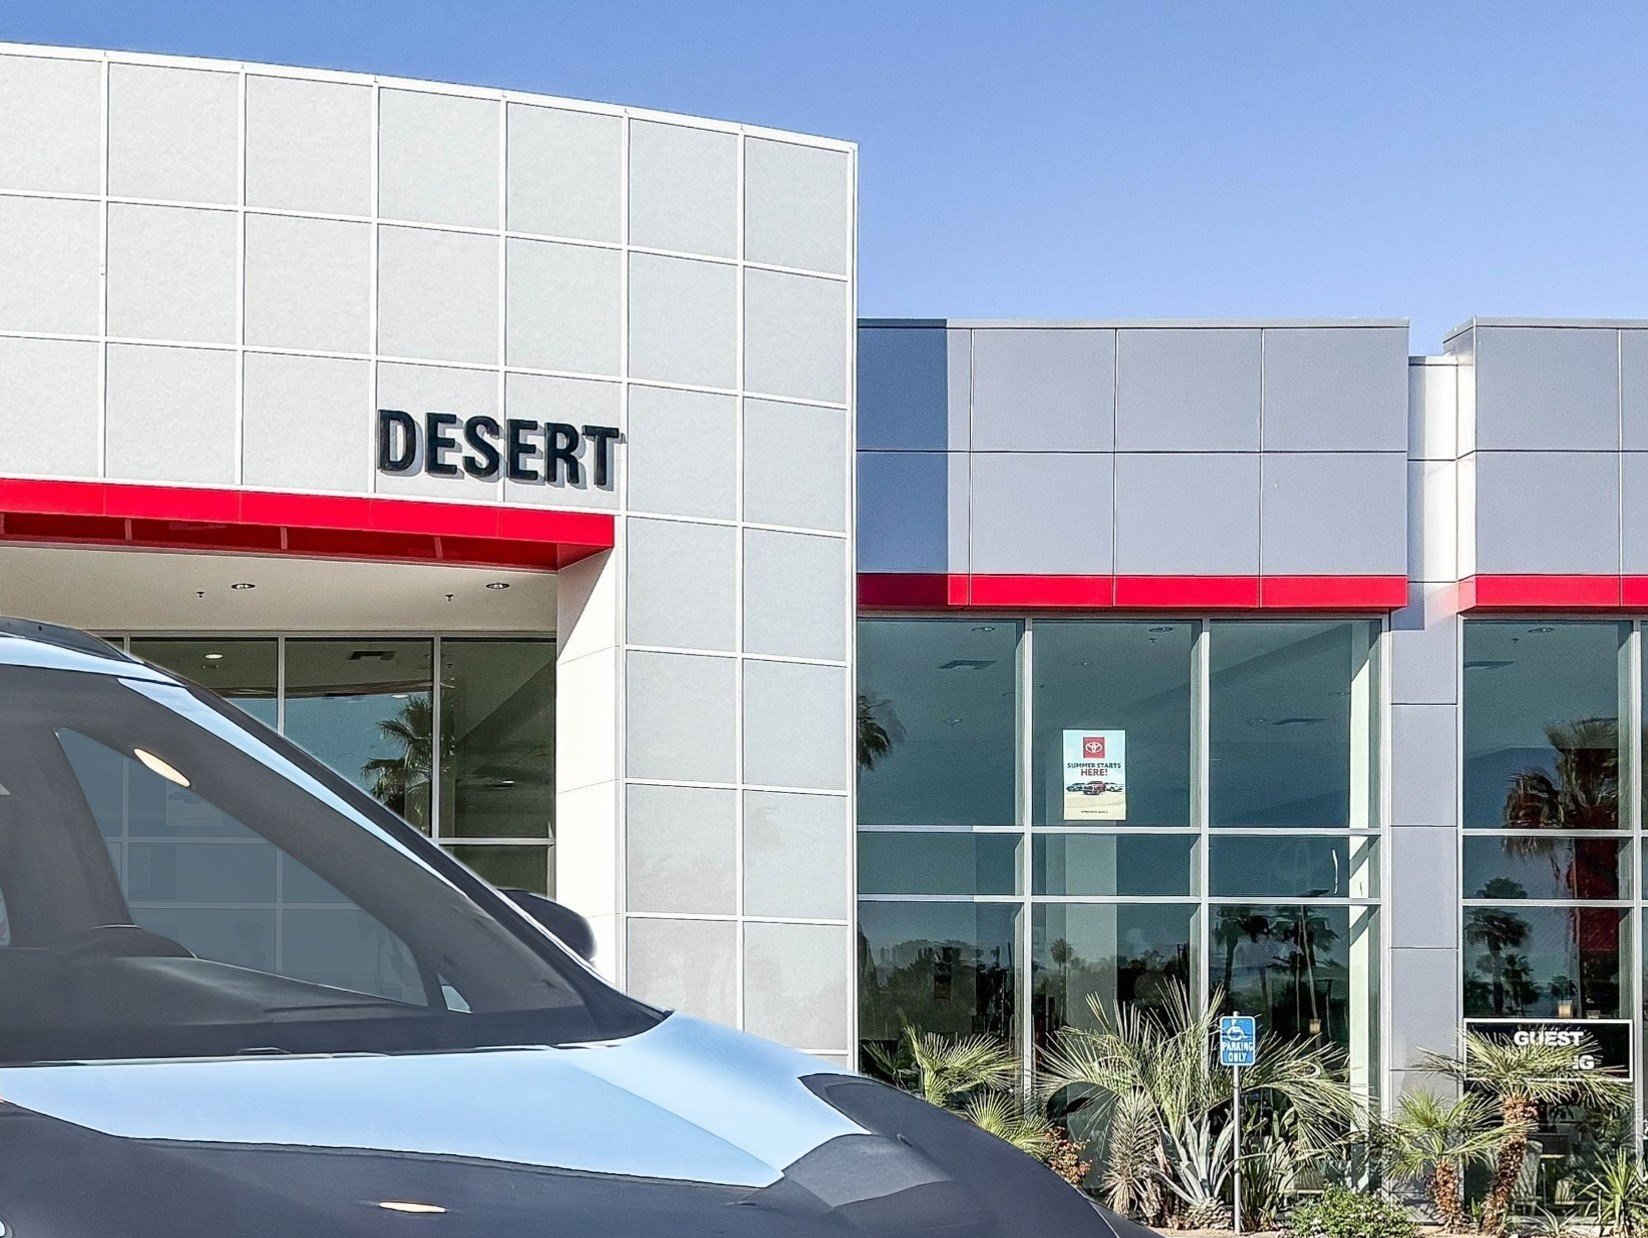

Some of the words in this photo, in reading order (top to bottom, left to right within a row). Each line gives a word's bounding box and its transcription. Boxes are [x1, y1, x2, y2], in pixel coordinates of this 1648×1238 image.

[377, 409, 620, 486] DESERT
[1080, 768, 1108, 777] HERE!
[1513, 1030, 1584, 1047] GUEST
[1222, 1041, 1253, 1052] PARKING
[1228, 1051, 1248, 1063] ONLY
